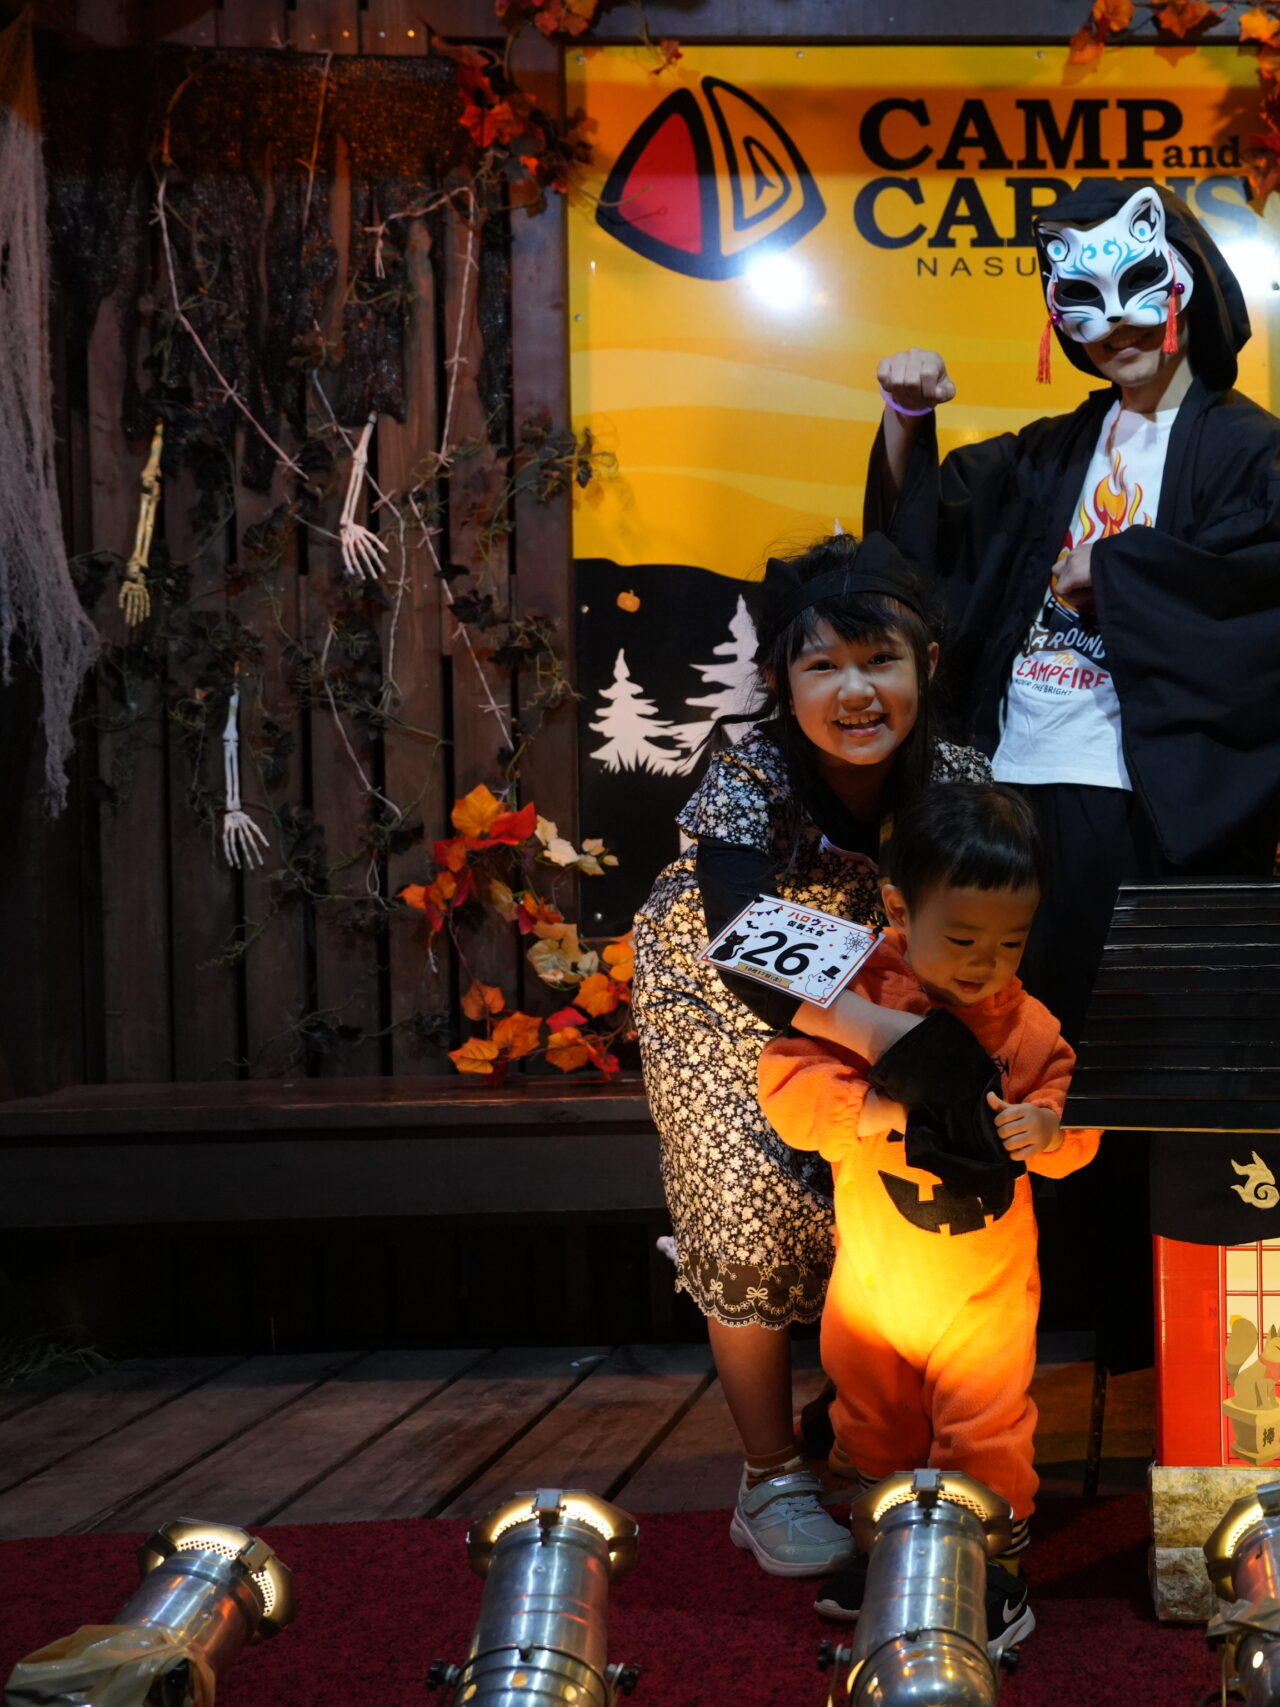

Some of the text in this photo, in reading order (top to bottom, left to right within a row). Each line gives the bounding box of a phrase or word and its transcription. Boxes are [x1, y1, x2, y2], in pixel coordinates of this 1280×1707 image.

[859, 98, 1243, 171] CAMP and
[853, 176, 1259, 249] CABS
[916, 256, 1036, 277] NASU
[1017, 660, 1109, 689] CAMPFIRE
[1044, 685, 1073, 696] BRIGHT
[788, 911, 838, 932] ハロウィン
[739, 930, 819, 976] 26
